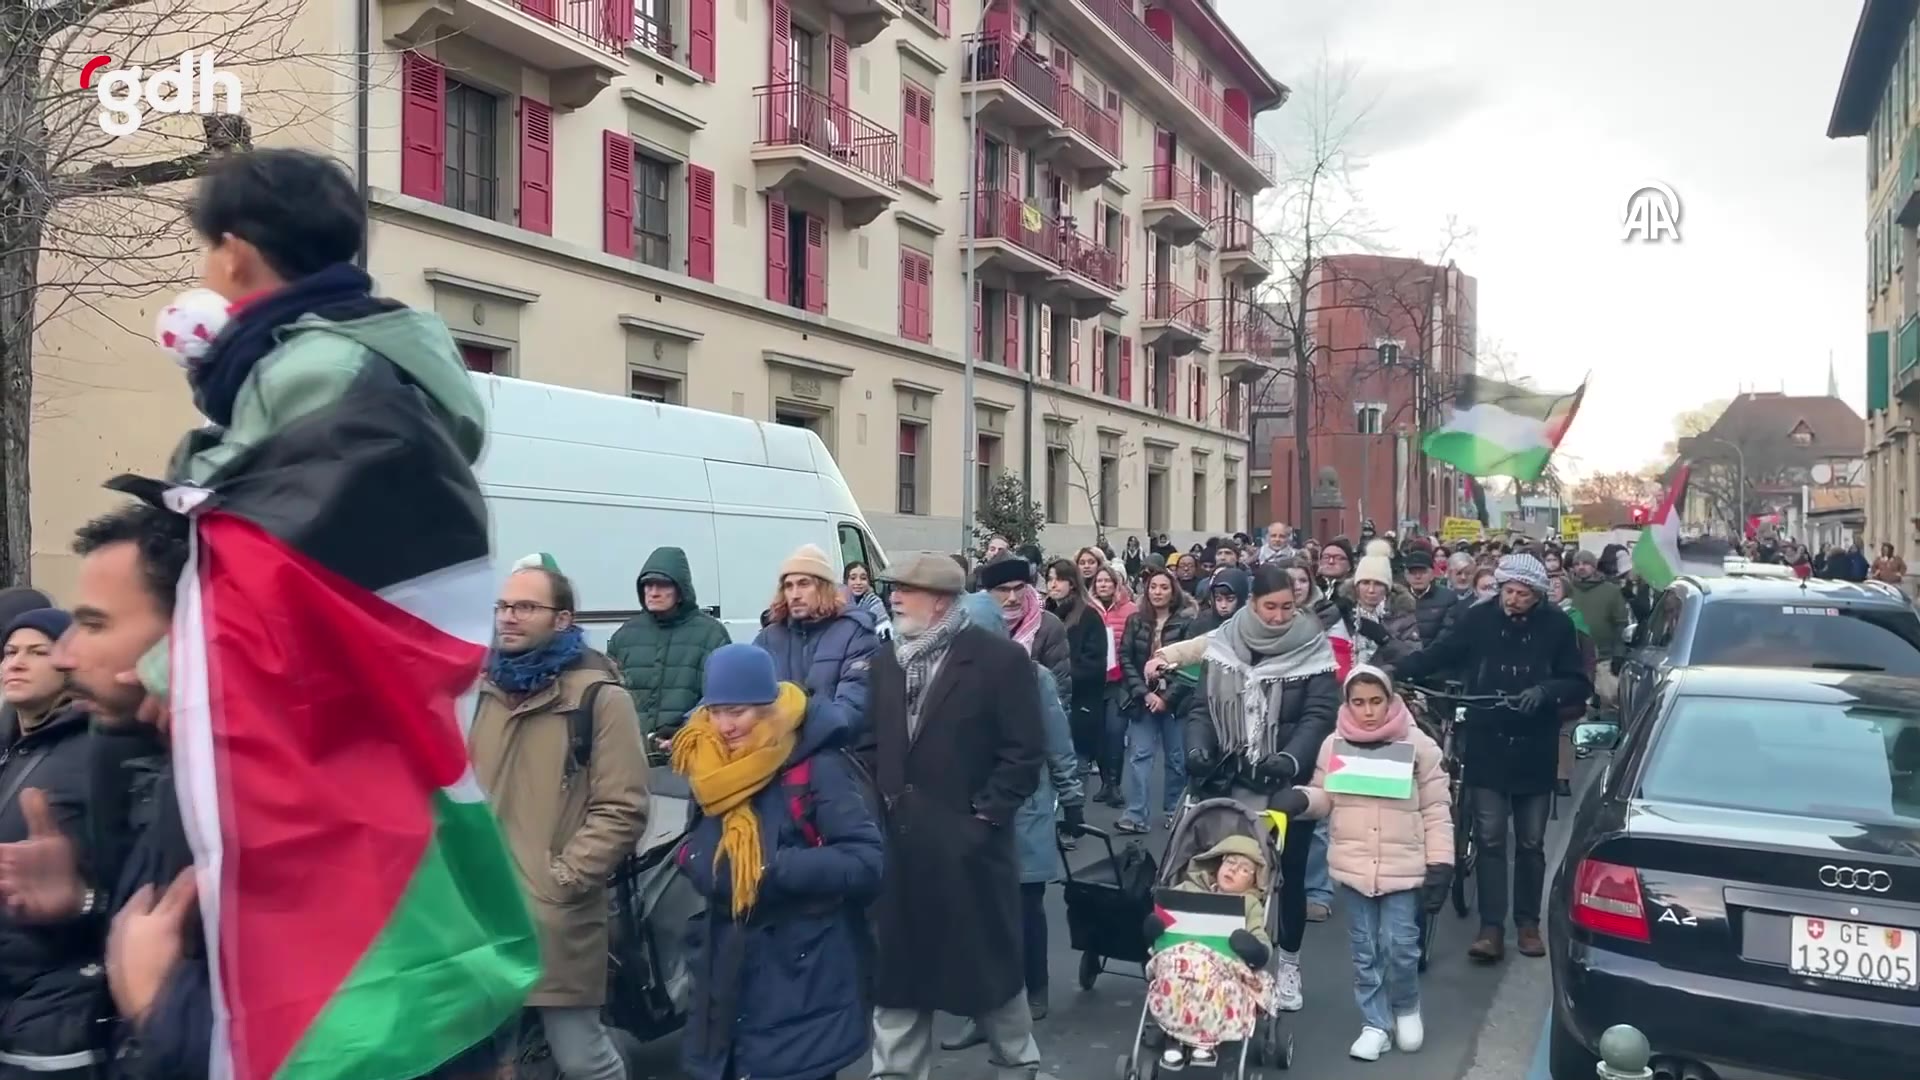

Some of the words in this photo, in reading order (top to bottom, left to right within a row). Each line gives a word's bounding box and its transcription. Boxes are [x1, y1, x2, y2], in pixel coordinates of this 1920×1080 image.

[1840, 924, 1869, 946] GE
[1798, 945, 1848, 975] 139
[1858, 953, 1911, 984] 005
